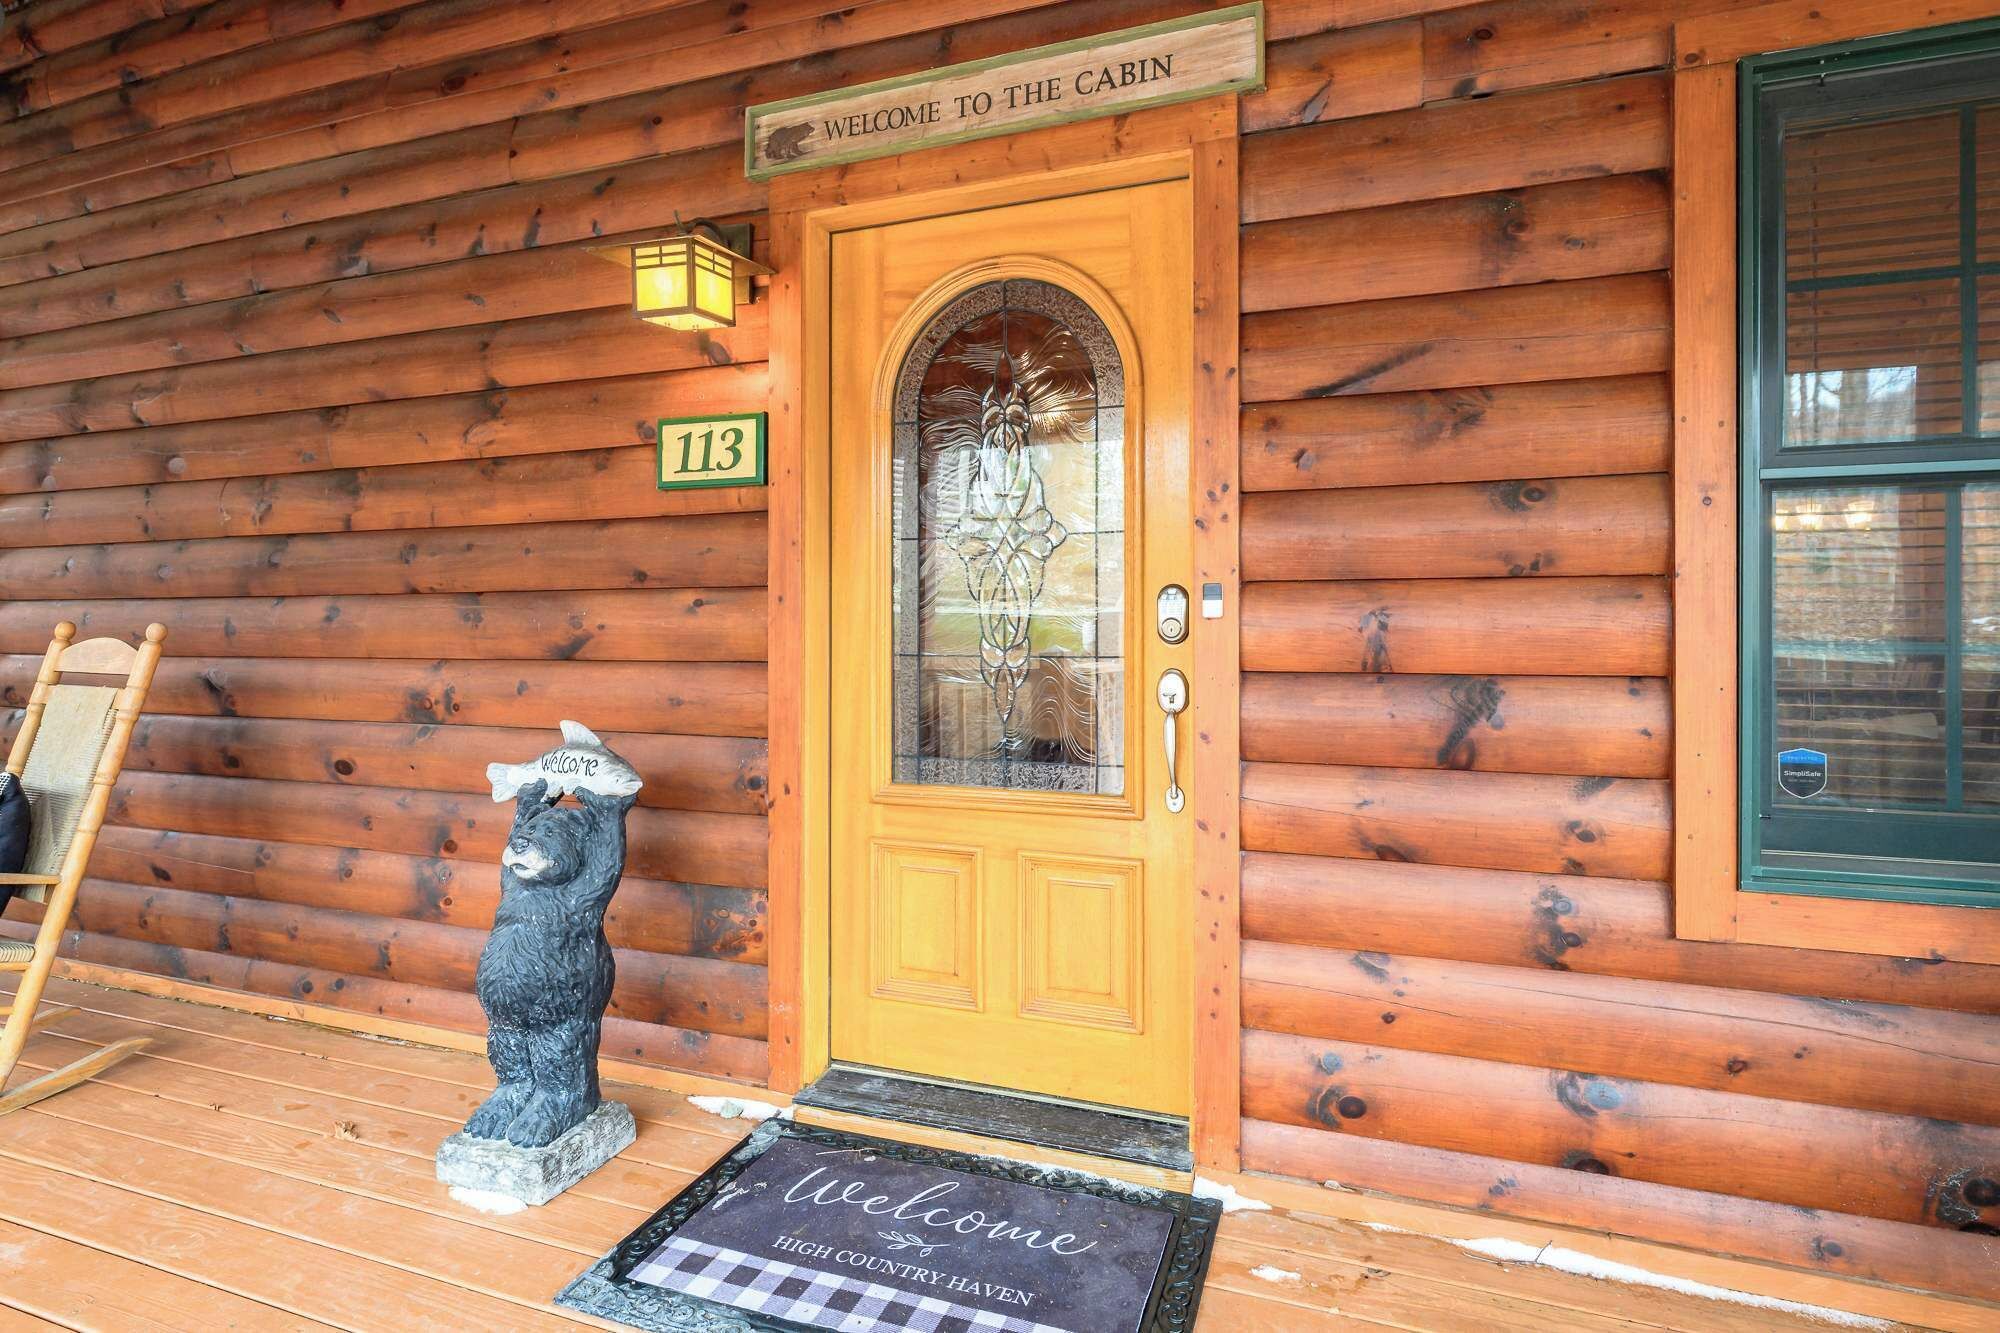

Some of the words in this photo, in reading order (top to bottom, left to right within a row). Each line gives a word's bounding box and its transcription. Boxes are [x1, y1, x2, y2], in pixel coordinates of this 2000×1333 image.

[824, 101, 941, 141] WELCOME
[954, 91, 993, 119] TO
[1003, 77, 1062, 109] THE
[1075, 54, 1174, 96] CABIN
[674, 427, 744, 474] 113
[784, 1166, 1098, 1255] Welcome
[771, 1235, 835, 1259] HIGH
[835, 1250, 946, 1285] COUNTRY
[946, 1275, 1035, 1307] HAVEN
